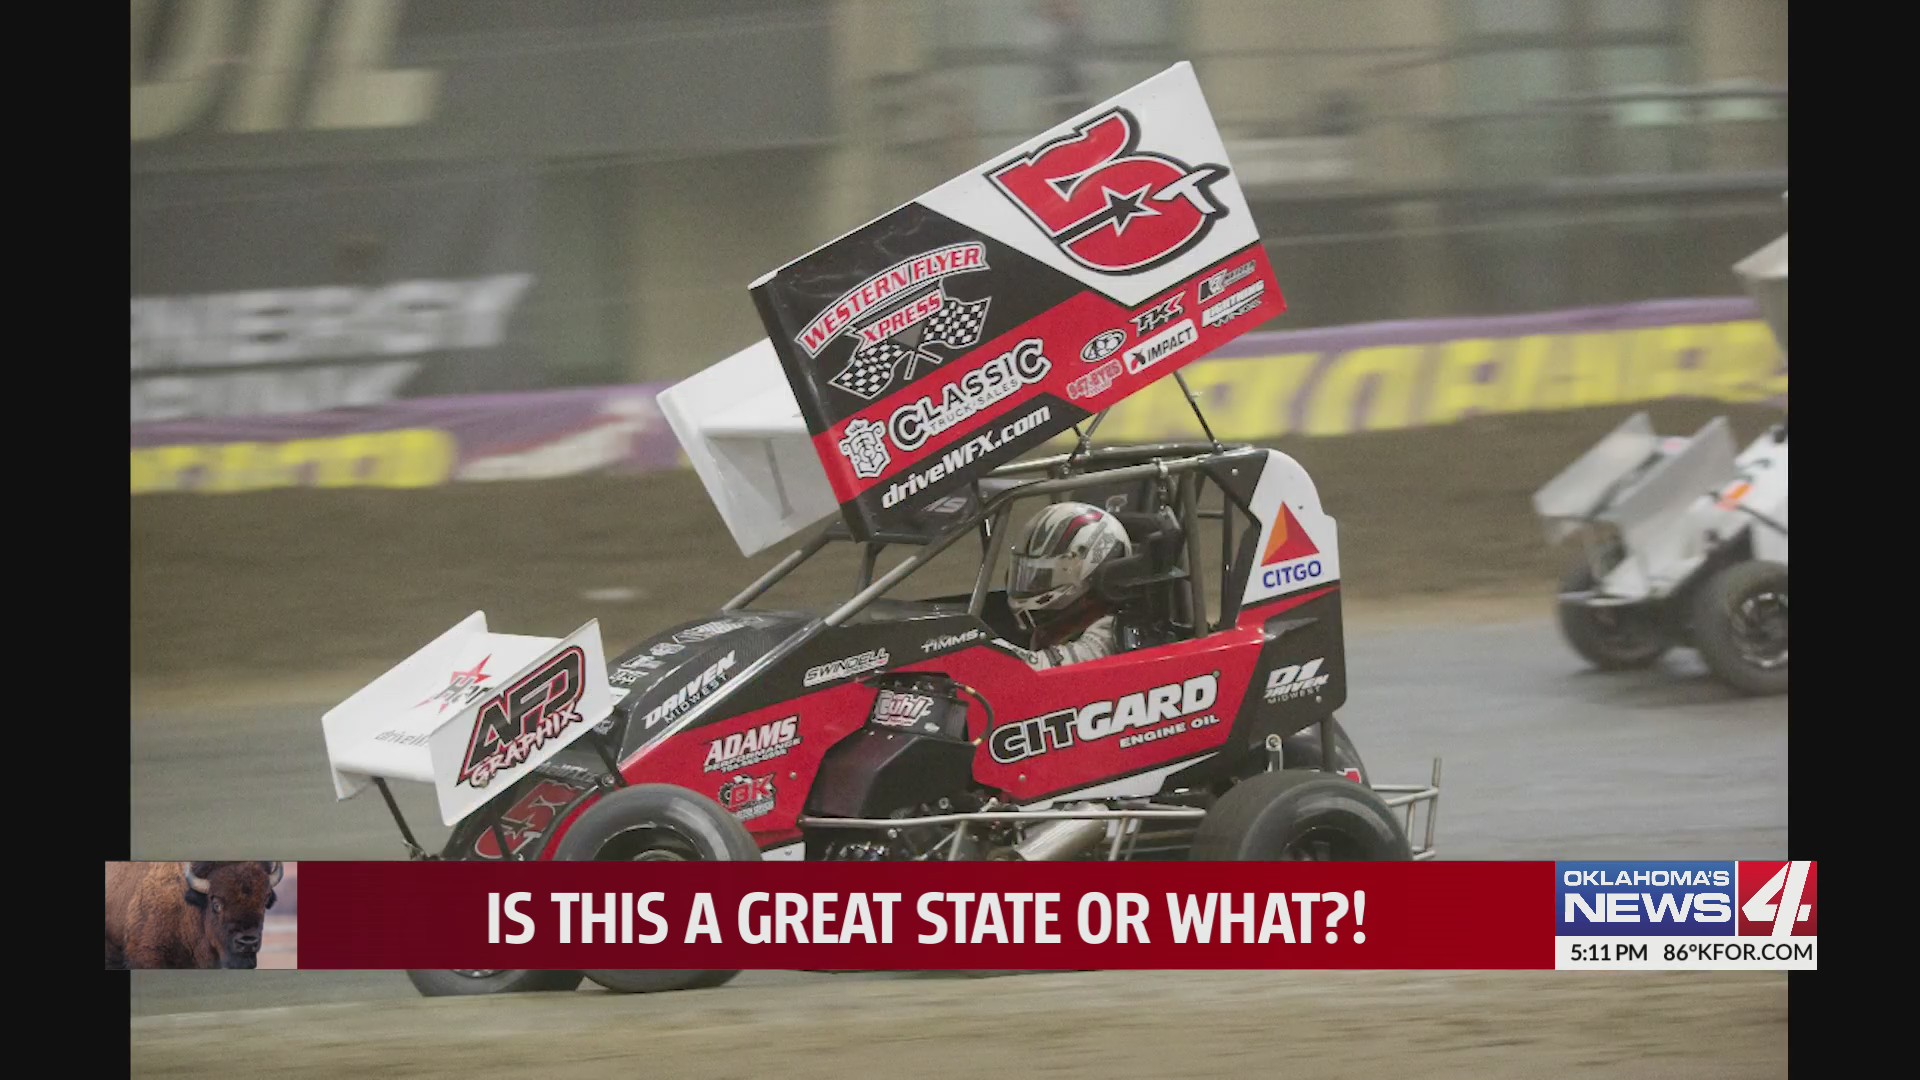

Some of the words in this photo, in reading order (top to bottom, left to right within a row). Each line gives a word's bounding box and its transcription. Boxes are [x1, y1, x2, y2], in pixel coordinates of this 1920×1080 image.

[803, 268, 908, 350] WESTERN
[913, 247, 981, 281] FLYER
[862, 292, 942, 345] XPRESS
[1147, 327, 1193, 362] IMPACT
[889, 338, 1052, 451] CLASSIC
[930, 403, 974, 431] TRUCK
[977, 379, 1020, 405] SALES
[881, 405, 1051, 509] driveWFX.com
[1262, 559, 1323, 590] CITGO
[806, 648, 890, 682] SWINDELL
[921, 629, 979, 653] TIMMS
[642, 650, 737, 730] DRIVEN
[664, 673, 728, 724] MIDWEST
[1266, 657, 1325, 689] D1
[703, 715, 800, 767] ADAMS
[989, 674, 1218, 764] CITGARD
[1119, 722, 1187, 749] ENGINE
[1190, 714, 1221, 730] OIL
[469, 703, 584, 789] GRAPHIX
